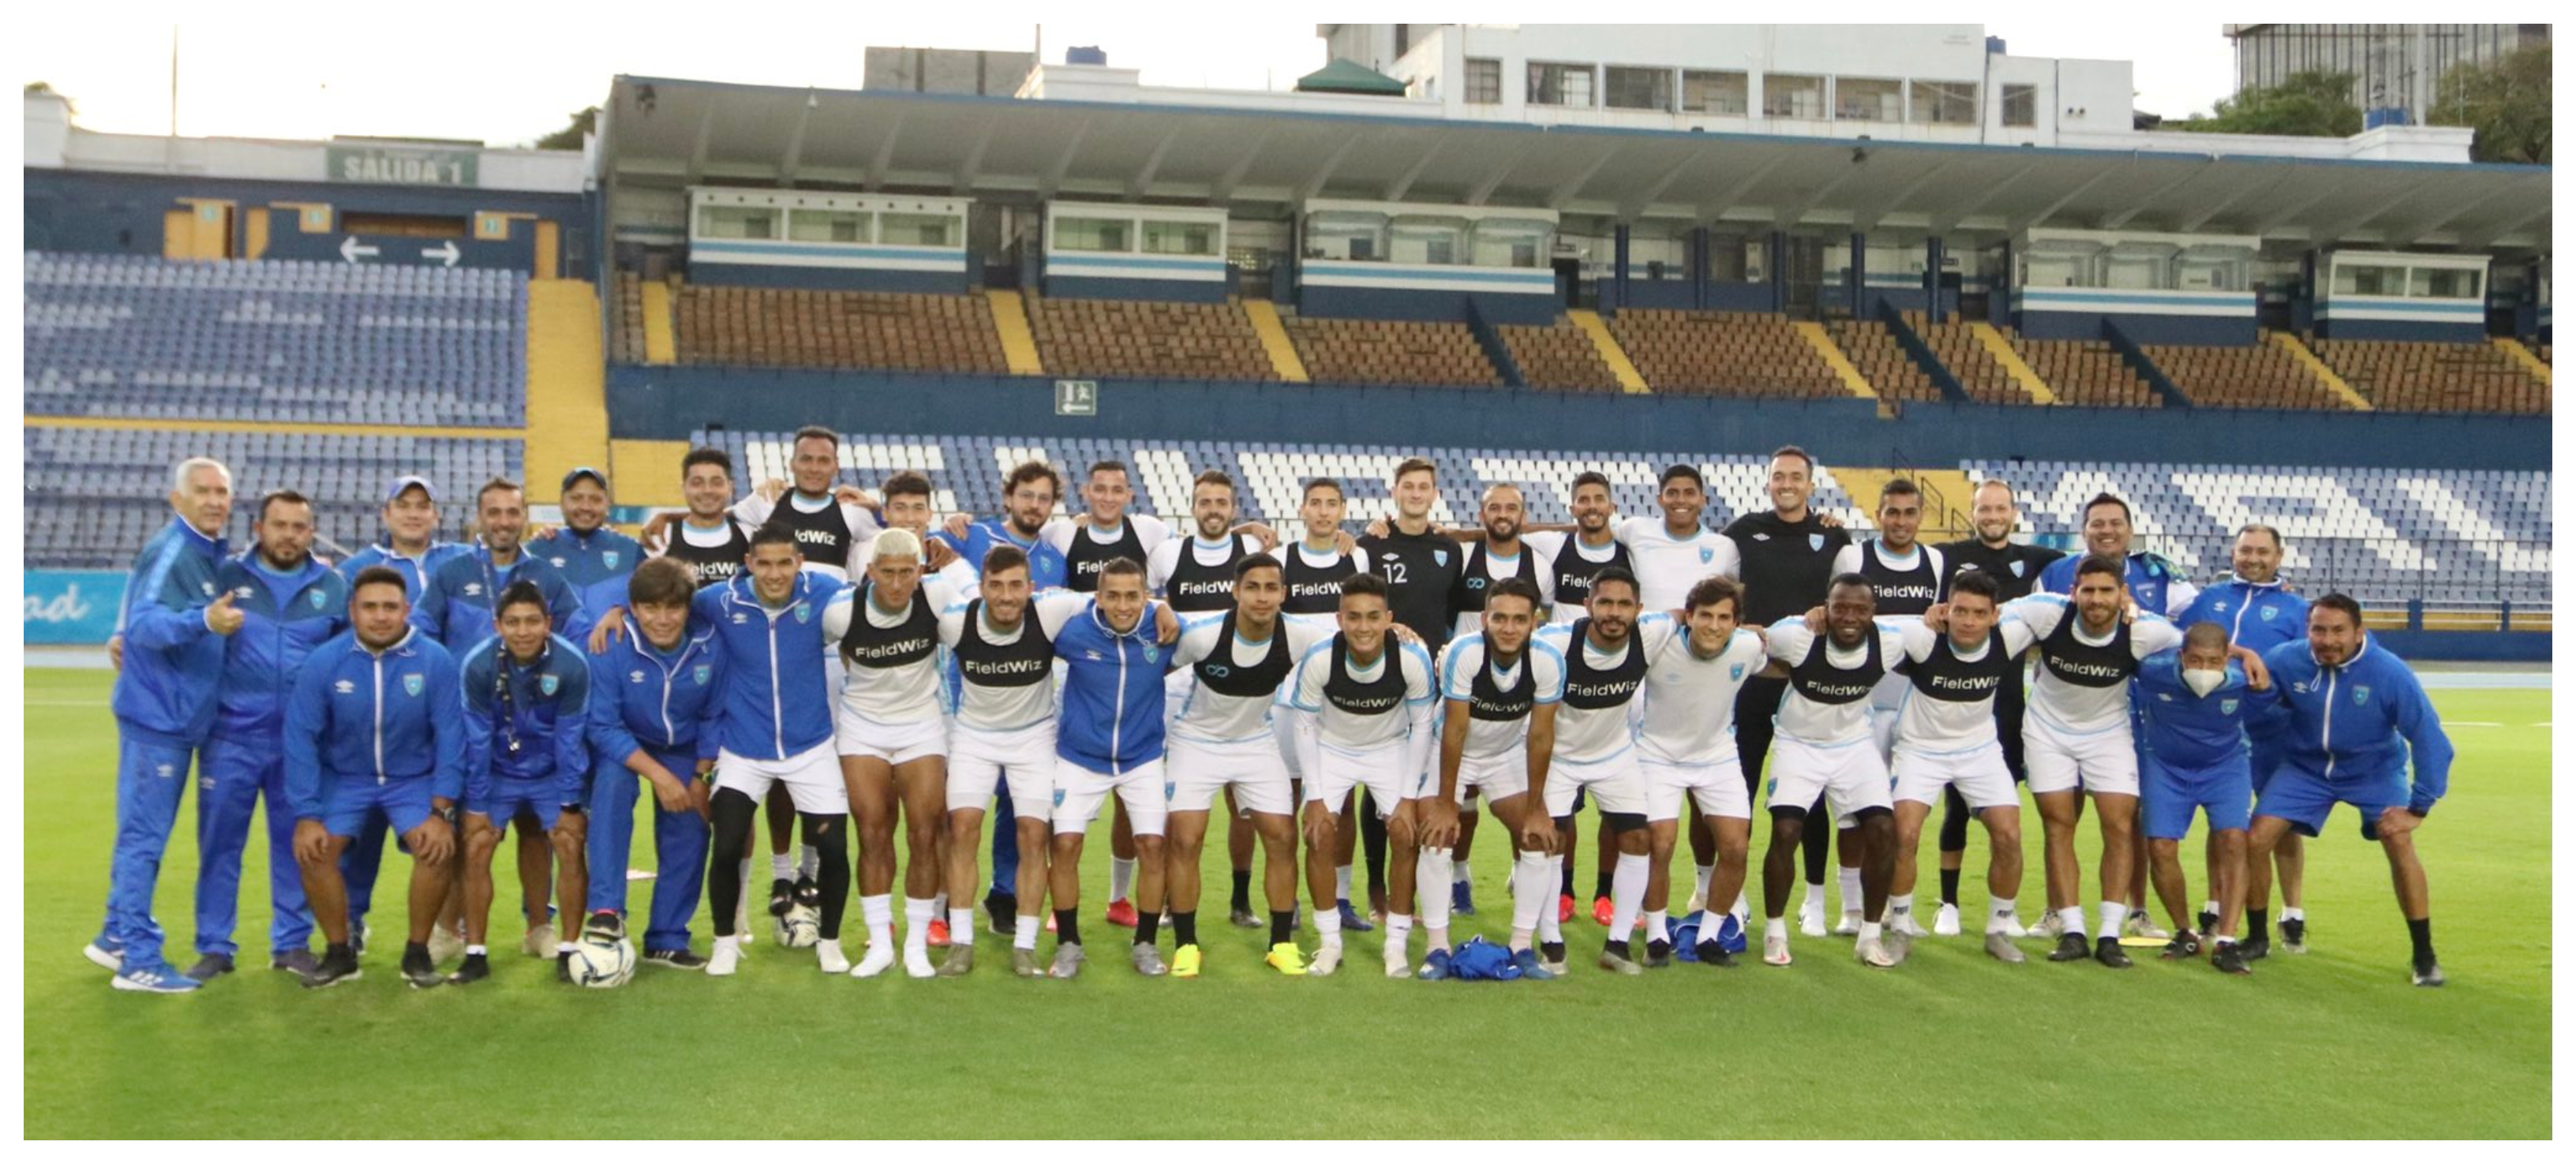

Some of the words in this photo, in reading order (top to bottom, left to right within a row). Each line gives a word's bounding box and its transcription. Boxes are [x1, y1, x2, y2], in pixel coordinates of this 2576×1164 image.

[344, 155, 439, 184] SALIDA
[448, 161, 462, 185] 1
[1382, 563, 1408, 584] 12
[855, 638, 930, 658] FieldWiz
[964, 660, 1043, 674] FieldWiz
[2050, 655, 2121, 677] FieldWiz
[1567, 680, 1638, 697] FieldWiz
[1932, 676, 2000, 690] FieldWiz
